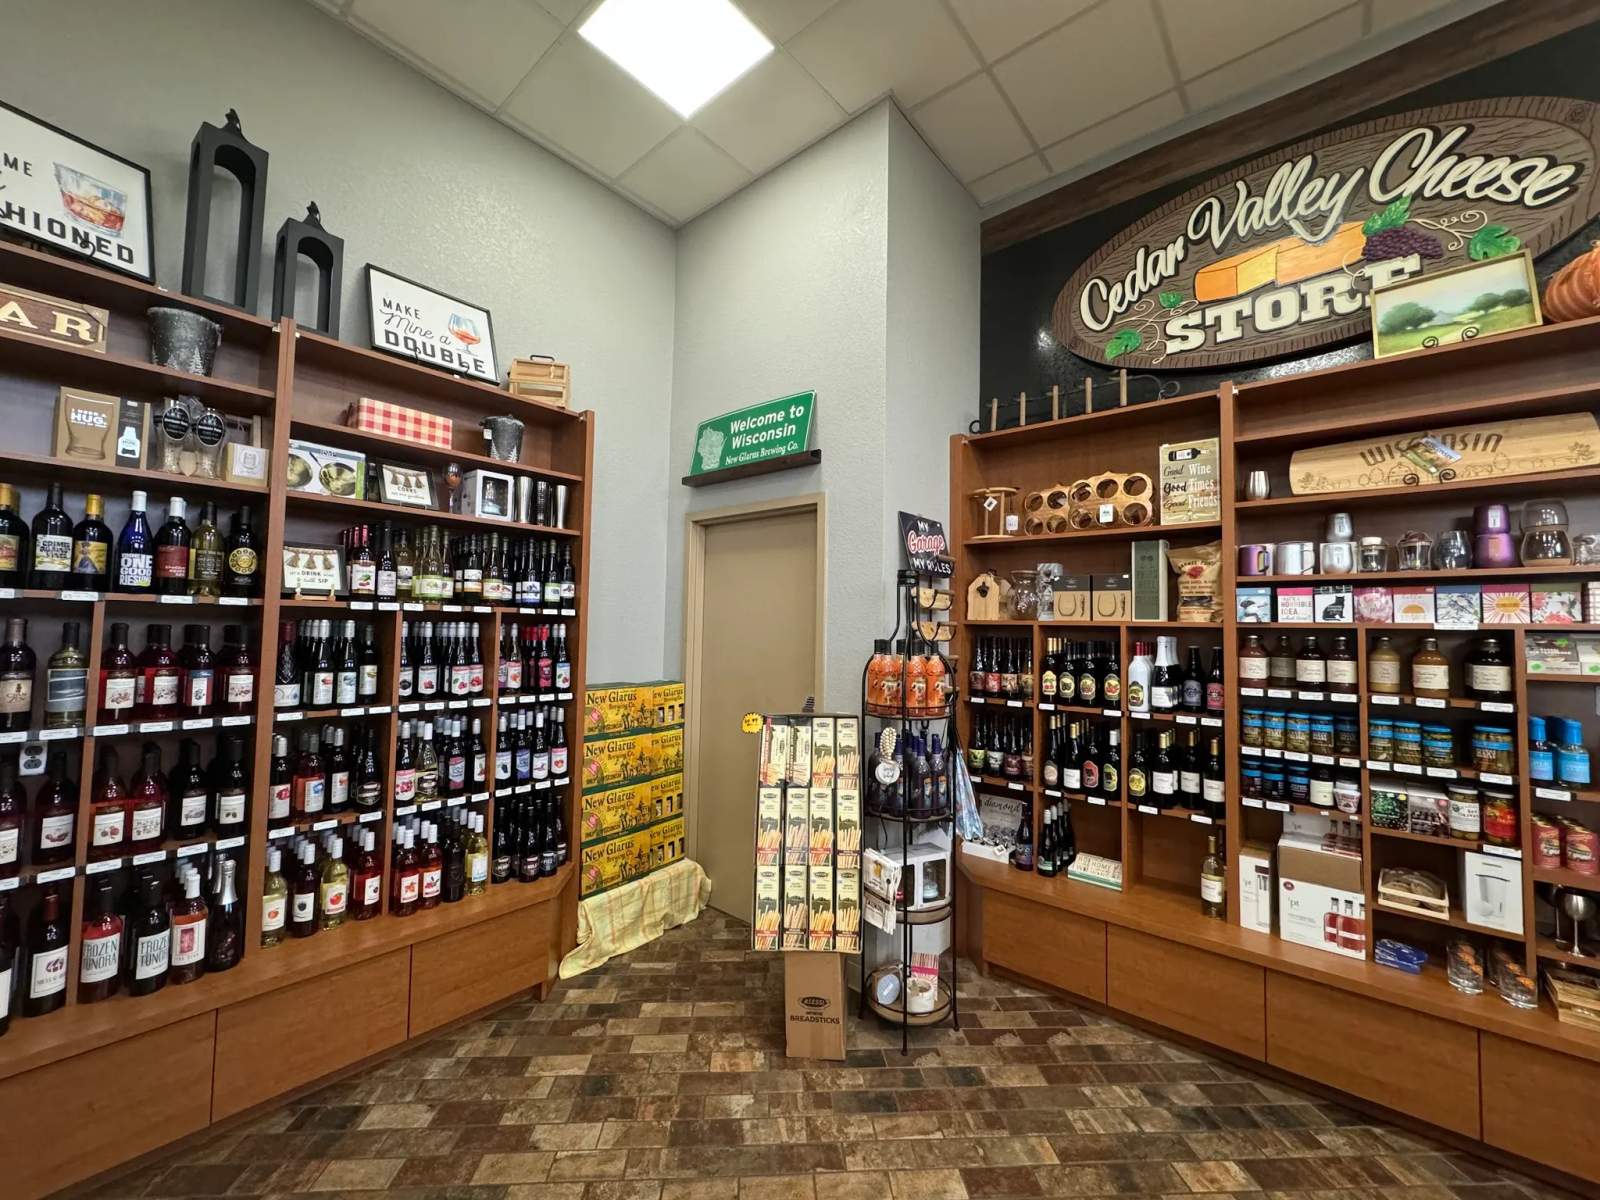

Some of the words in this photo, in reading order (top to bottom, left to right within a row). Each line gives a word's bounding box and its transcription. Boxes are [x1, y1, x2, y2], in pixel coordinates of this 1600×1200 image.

[1080, 236, 1185, 331] Cedar
[1188, 155, 1365, 241] Valley
[1369, 125, 1575, 206] Cheese
[383, 298, 420, 319] MAKE
[379, 309, 434, 339] Mine
[440, 335, 451, 345] a
[385, 329, 486, 374] DOUBLE
[730, 410, 785, 434] Welcome
[790, 404, 804, 418] to
[732, 423, 796, 450] Wisconsin
[725, 456, 738, 466] New
[739, 451, 760, 462] Glarus
[760, 445, 786, 458] Brewing
[787, 441, 799, 451] Co.
[1189, 464, 1211, 476] Wine
[1188, 492, 1217, 508] Friends
[918, 520, 929, 532] MY
[908, 530, 945, 556] Garage
[120, 554, 153, 568] ONE
[912, 557, 925, 570] MY
[587, 693, 607, 705] New
[608, 691, 637, 703] Glarus
[586, 744, 606, 757] New
[607, 741, 636, 752] Glarus
[585, 798, 605, 810] New
[606, 791, 635, 804] Glarus
[585, 851, 605, 863] New
[606, 840, 634, 855] Glarus
[141, 937, 168, 954] FROZE
[140, 949, 168, 967] TUND
[790, 1015, 840, 1025] BREADSTICKS
